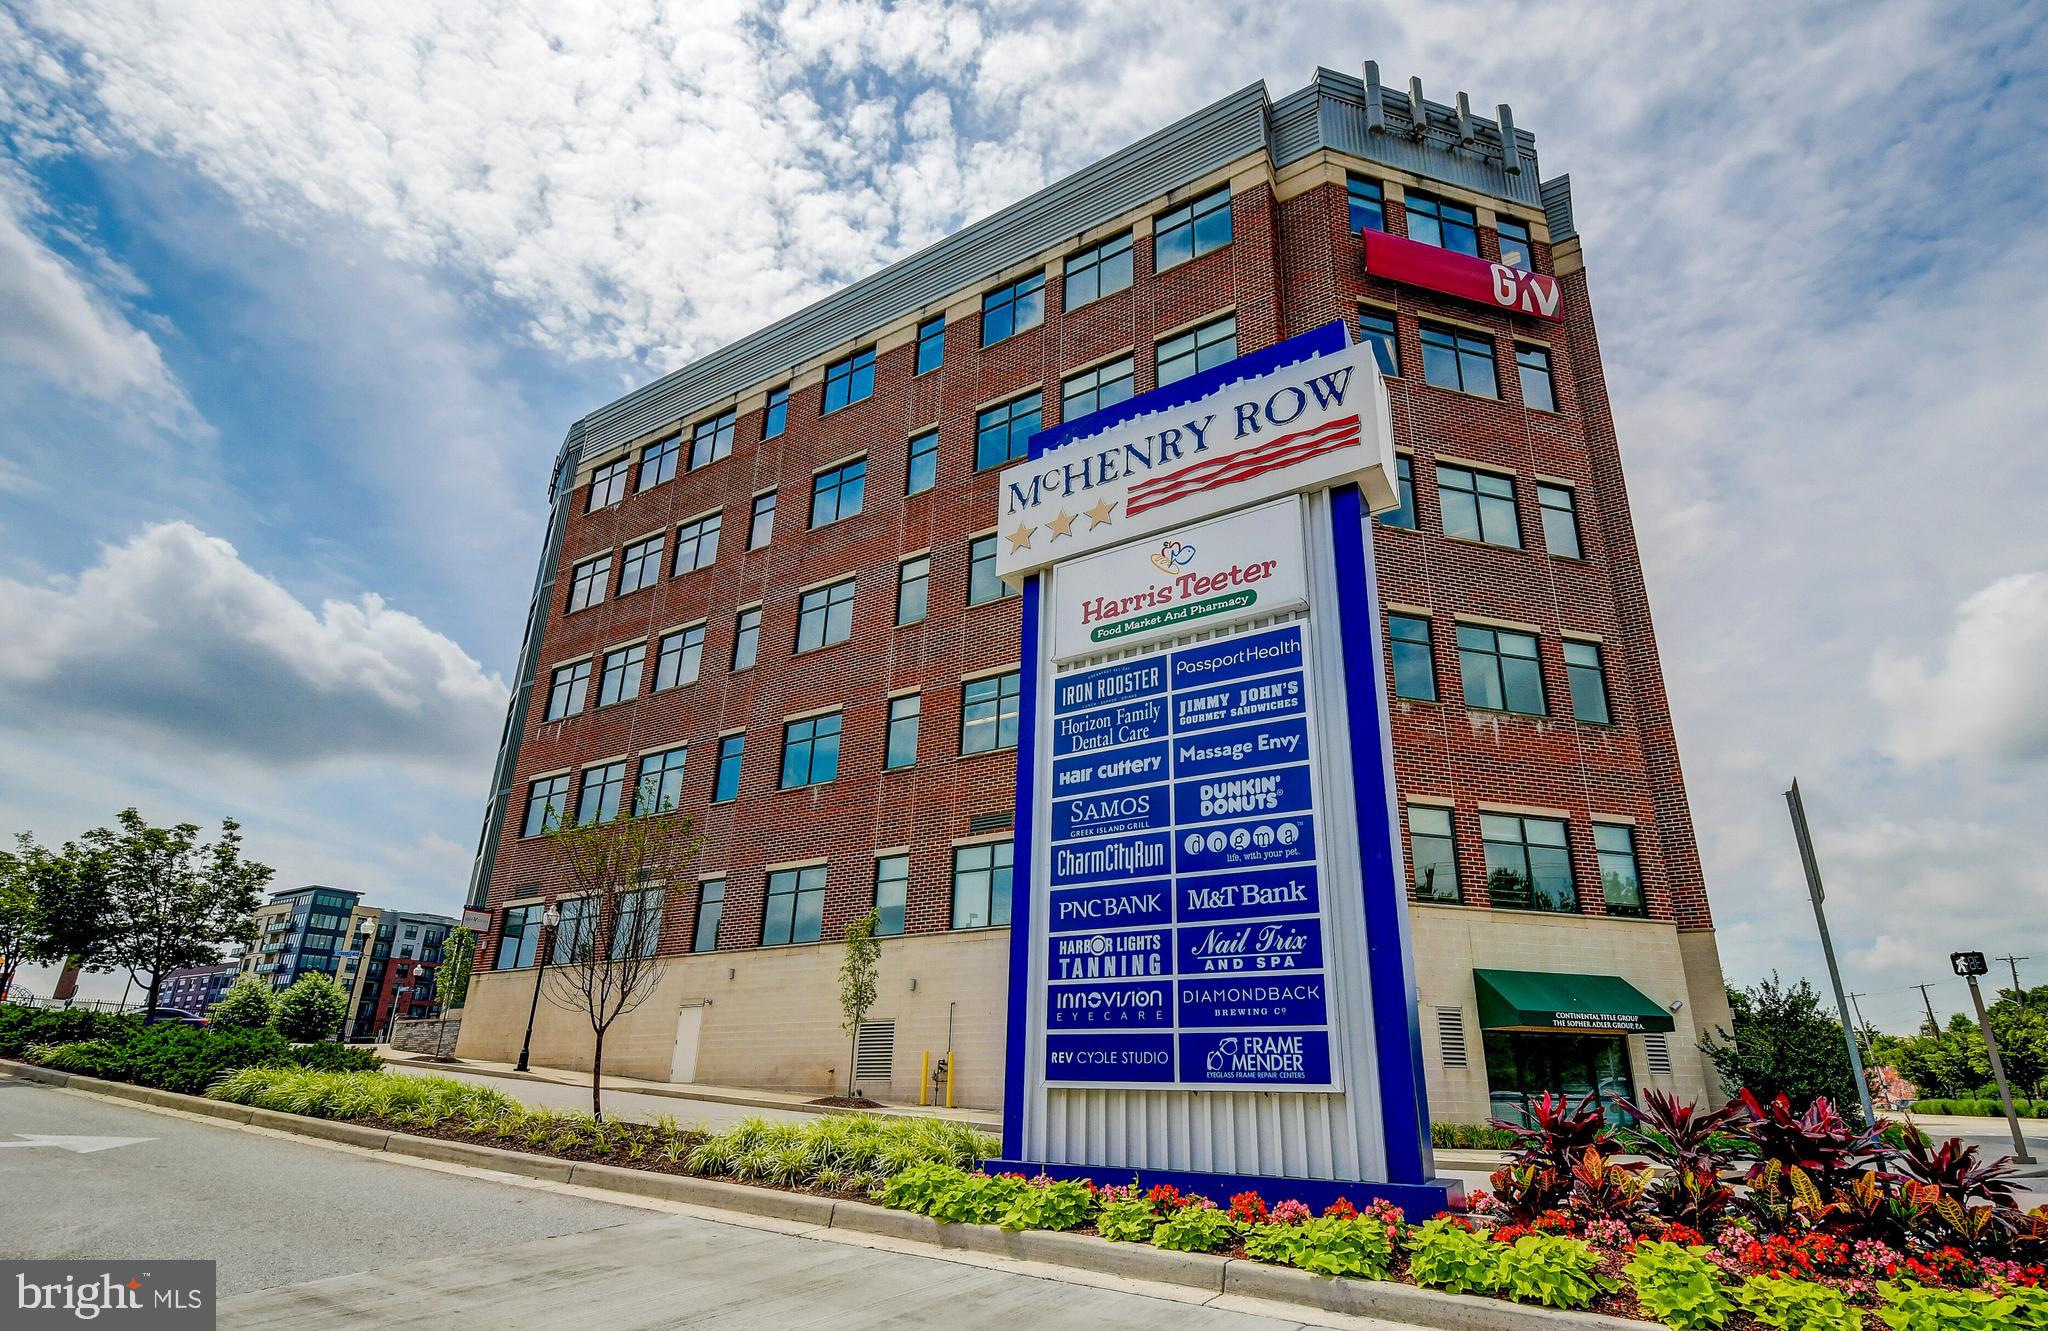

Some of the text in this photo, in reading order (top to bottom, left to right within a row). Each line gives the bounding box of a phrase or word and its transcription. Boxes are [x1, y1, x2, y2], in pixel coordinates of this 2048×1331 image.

[1234, 365, 1355, 440] ROW
[1081, 559, 1277, 625] Harris Teeter
[1097, 595, 1249, 638] Food Market And Pharmacy
[1062, 667, 1159, 706] IRON ROOSTER
[1179, 680, 1299, 717] JIMMY JOHN'S
[1061, 701, 1160, 736] Horizon Family
[1179, 697, 1299, 725] GOURMET SANDWICHES
[1072, 726, 1150, 752] Dental Care
[1179, 733, 1300, 763] Massage Envy
[1059, 756, 1161, 786] Hair cuttery
[1200, 775, 1281, 801] DUNKIN'
[1070, 795, 1150, 822] SAMOS
[1200, 792, 1278, 817] DONUTS
[1070, 821, 1150, 838] GREEK ISLAND GRILL
[1189, 827, 1295, 854] dogma
[1226, 847, 1301, 862] life, with your pet.
[1058, 893, 1162, 920] PNC BANK
[1187, 880, 1308, 910] M&T Bank
[1059, 934, 1161, 956] HARBOR LIGHTS
[1191, 924, 1308, 955] Nail Trix
[1059, 953, 1161, 979] TANNING
[1204, 955, 1295, 971] AND SPA
[1183, 985, 1320, 1003] DIAMONDBACK
[1056, 1010, 1163, 1021] EYECARE
[1214, 1007, 1268, 1017] BREWING
[1555, 1012, 1639, 1022] CONTINENTAL TITLE GROUP
[1566, 1020, 1591, 1028] SOPHER
[1592, 1021, 1612, 1029] ADLER
[1051, 1051, 1073, 1064] REV
[1121, 1051, 1169, 1064] STUDIO
[1243, 1036, 1304, 1054] FRAME
[1206, 1071, 1306, 1079] EYEGLASS FRAME REPAIR CENTERS
[1231, 1054, 1304, 1071] MENDER
